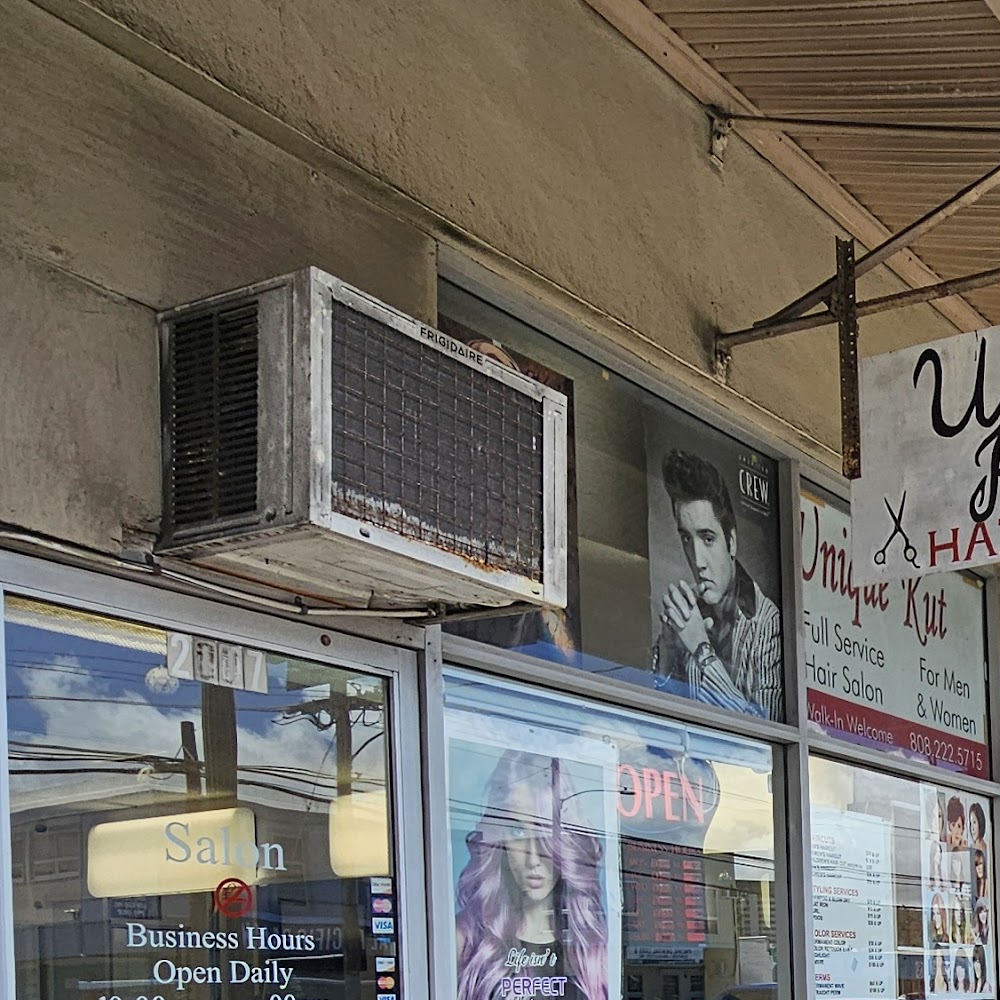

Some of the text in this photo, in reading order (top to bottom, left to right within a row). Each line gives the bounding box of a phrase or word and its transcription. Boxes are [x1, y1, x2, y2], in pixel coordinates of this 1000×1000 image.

[420, 326, 484, 366] FRIGIDAIRE
[739, 468, 769, 505] CREW
[902, 576, 947, 647] Kut
[834, 623, 885, 669] Service
[805, 652, 884, 705] Hair Salon
[919, 657, 970, 699] For Men
[845, 713, 894, 745] Welcome
[917, 693, 977, 735] & Women
[909, 732, 983, 771] 808.222.5715
[616, 763, 705, 823] OPEN
[165, 821, 288, 872] Salon
[812, 885, 859, 897] TYLING SERVICES
[126, 922, 316, 951] Business Hours
[375, 921, 393, 930] VISA
[814, 929, 856, 939] OLOR SERVICES
[153, 959, 294, 990] Open Daily
[505, 947, 530, 974] Life
[501, 977, 568, 998] PERFECT
